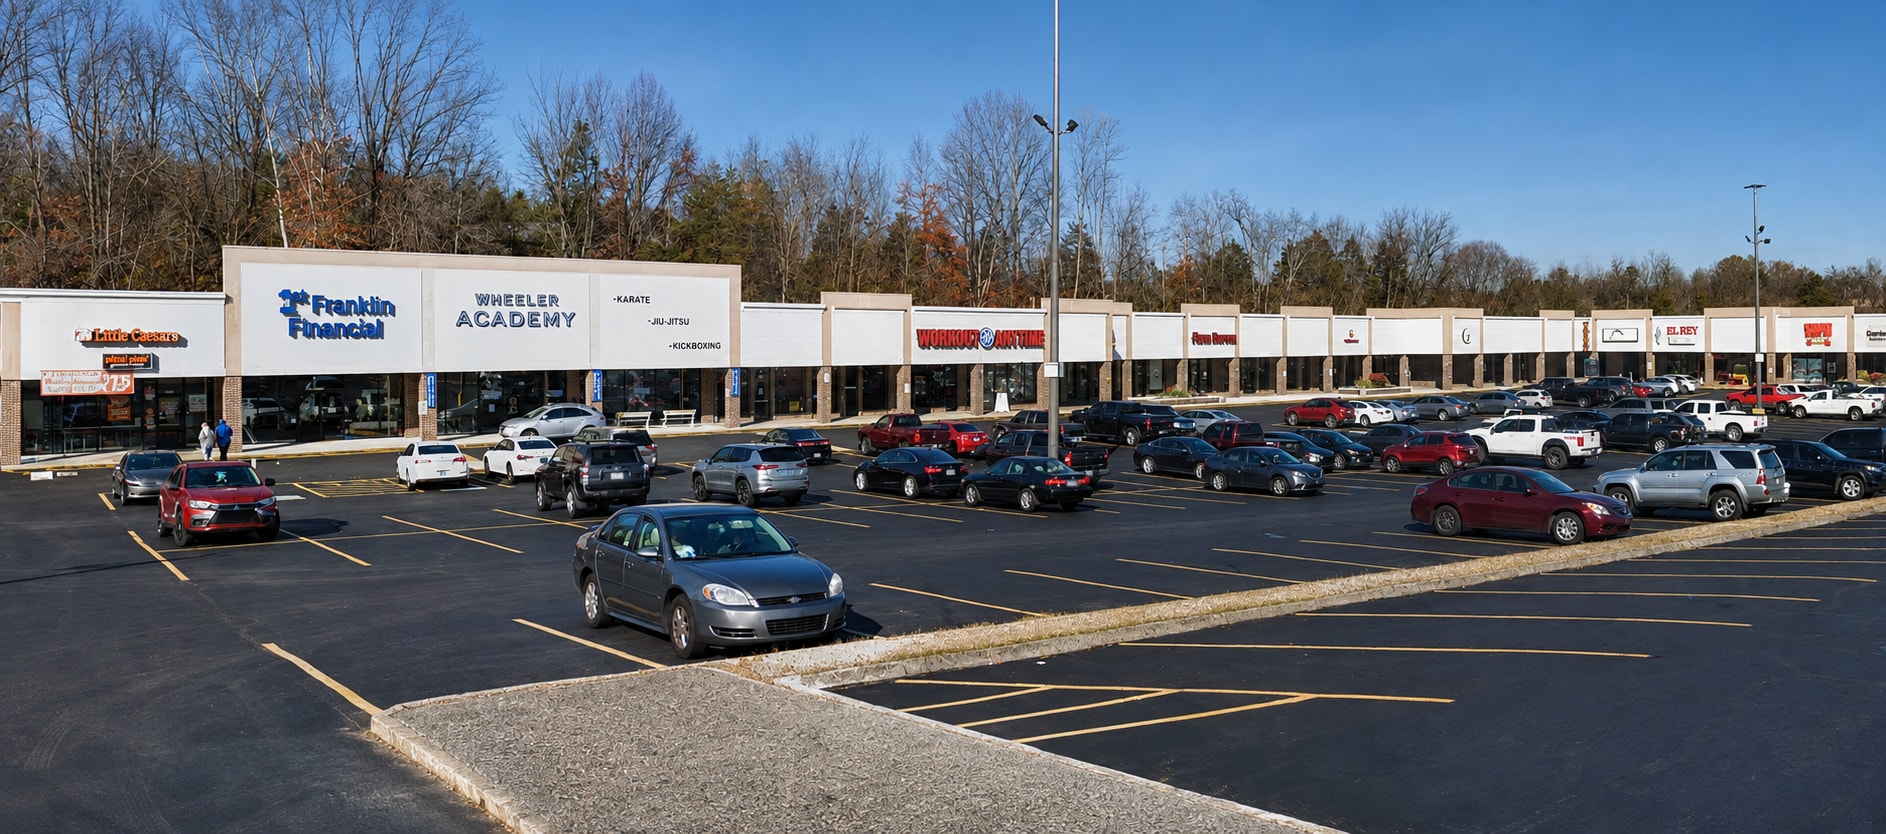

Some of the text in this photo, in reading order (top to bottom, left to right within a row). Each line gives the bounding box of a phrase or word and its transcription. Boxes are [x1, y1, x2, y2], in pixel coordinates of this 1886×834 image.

[312, 295, 396, 317] Franklin
[475, 293, 560, 307] WHEELER
[455, 310, 576, 328] ACADEMY
[93, 328, 179, 342] Little Caesars
[288, 318, 384, 340] Financial
[1666, 326, 1699, 336] EL REY
[916, 329, 980, 349] WORKOUT
[994, 330, 1046, 349] ANYTIME
